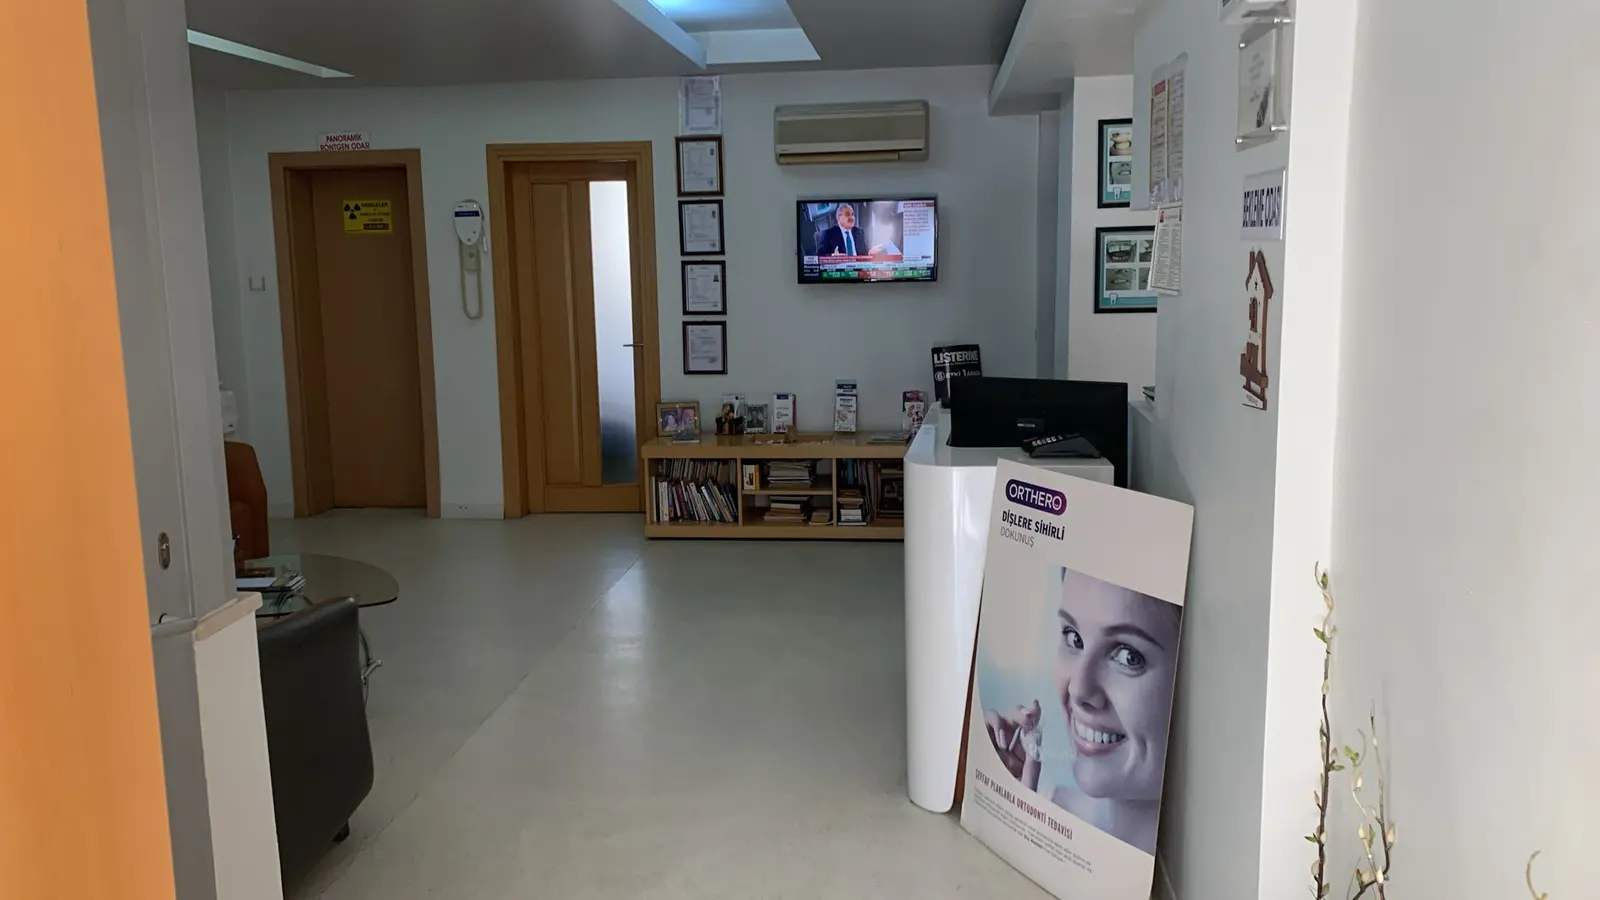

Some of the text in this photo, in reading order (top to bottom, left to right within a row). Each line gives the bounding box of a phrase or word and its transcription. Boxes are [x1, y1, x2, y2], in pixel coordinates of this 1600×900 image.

[1243, 188, 1264, 227] BEKLEME
[1009, 483, 1062, 511] ORTHERO
[1000, 526, 1035, 548] DOKUNUŞ
[1002, 509, 1066, 541] DİŞLERE SİHİRLİ
[1016, 797, 1047, 825] ORTODONTİ
[1047, 816, 1073, 841] TEDAVİSİ
